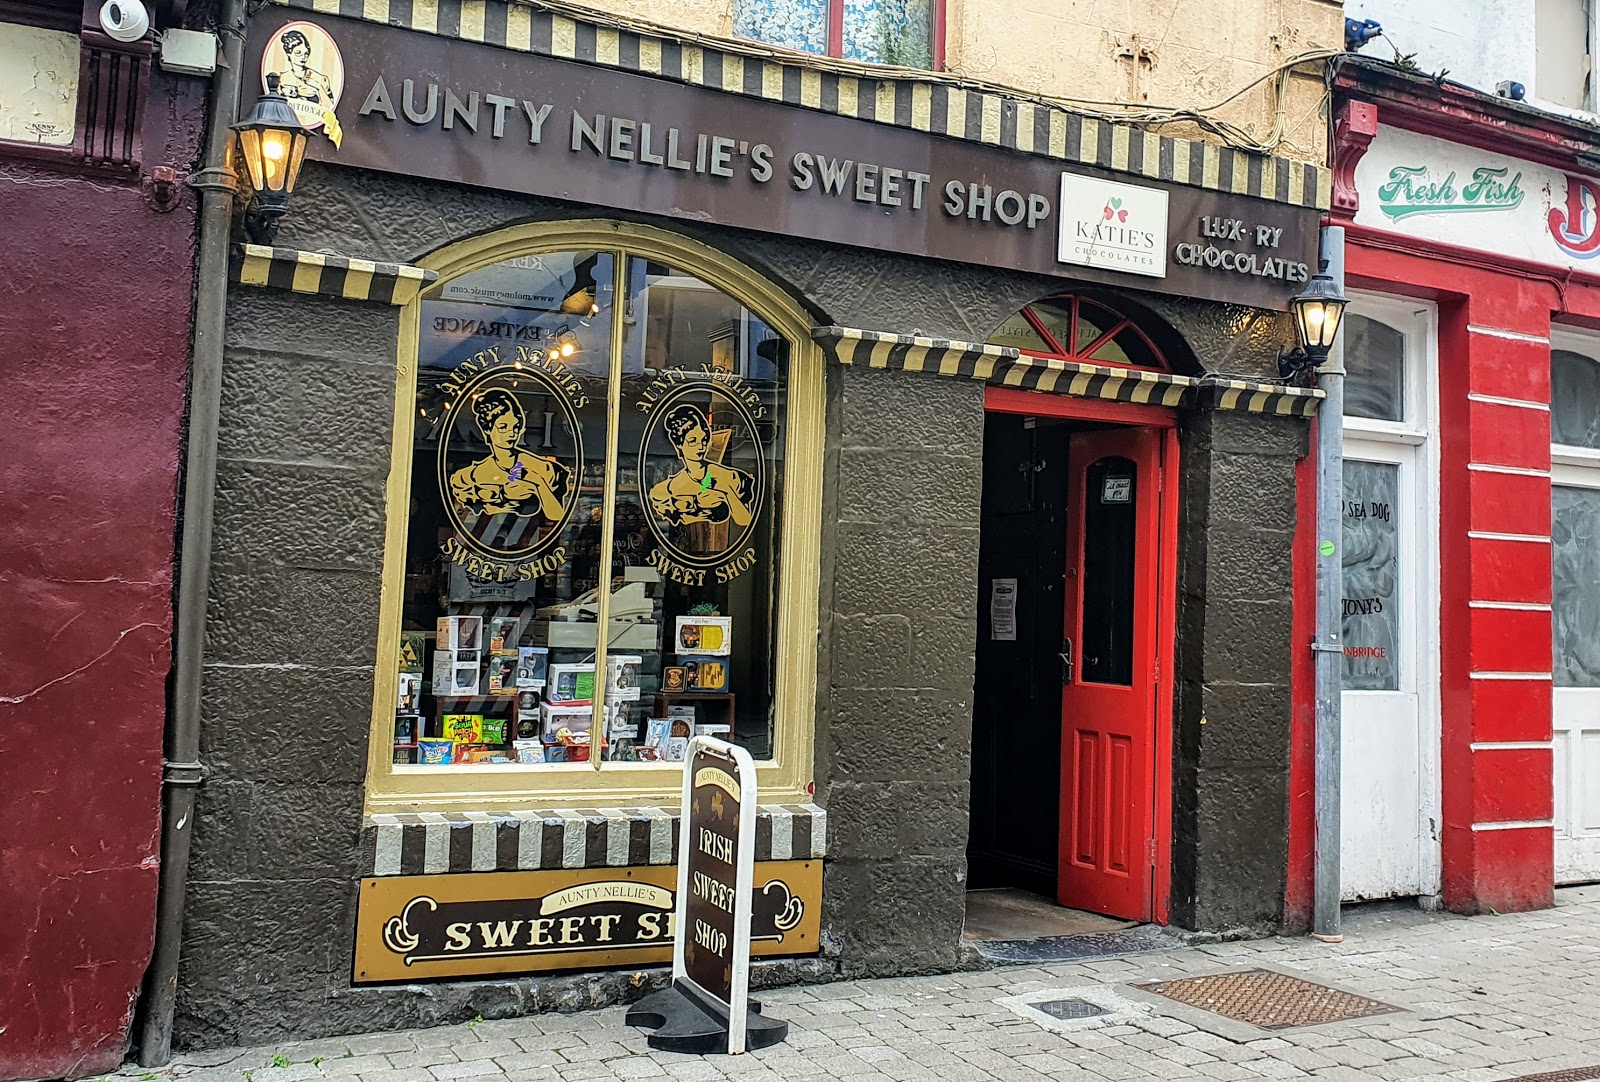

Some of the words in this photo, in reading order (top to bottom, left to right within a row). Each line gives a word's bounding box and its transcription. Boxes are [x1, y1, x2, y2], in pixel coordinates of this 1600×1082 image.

[358, 75, 554, 145] AUNTY
[570, 109, 774, 184] NELLIE'S
[792, 152, 931, 210] SWEET
[943, 179, 1051, 229] SHOP
[1378, 165, 1458, 204] Fresh
[1462, 166, 1526, 204] Fish
[1076, 220, 1154, 249] KATIE'S
[1074, 246, 1154, 266] CHOCOLATES
[1176, 242, 1309, 283] CHOCOLATES
[440, 345, 501, 397] AUNTY
[515, 344, 590, 410] NELLIE'S
[636, 364, 687, 415] AUNTY
[699, 362, 768, 419] NELLIE'S
[1348, 501, 1367, 518] SEA
[1371, 502, 1391, 523] DOG
[439, 537, 509, 583] SWEET
[518, 546, 568, 583] SHOP
[645, 548, 707, 587] SWEET
[714, 547, 758, 585] SHOP
[698, 826, 734, 866] IRISH
[558, 886, 601, 906] AUNTY
[603, 885, 657, 901] NELLIE'S
[693, 870, 736, 914] SWEET
[443, 913, 622, 951] SWEET
[694, 918, 727, 958] SHOP
